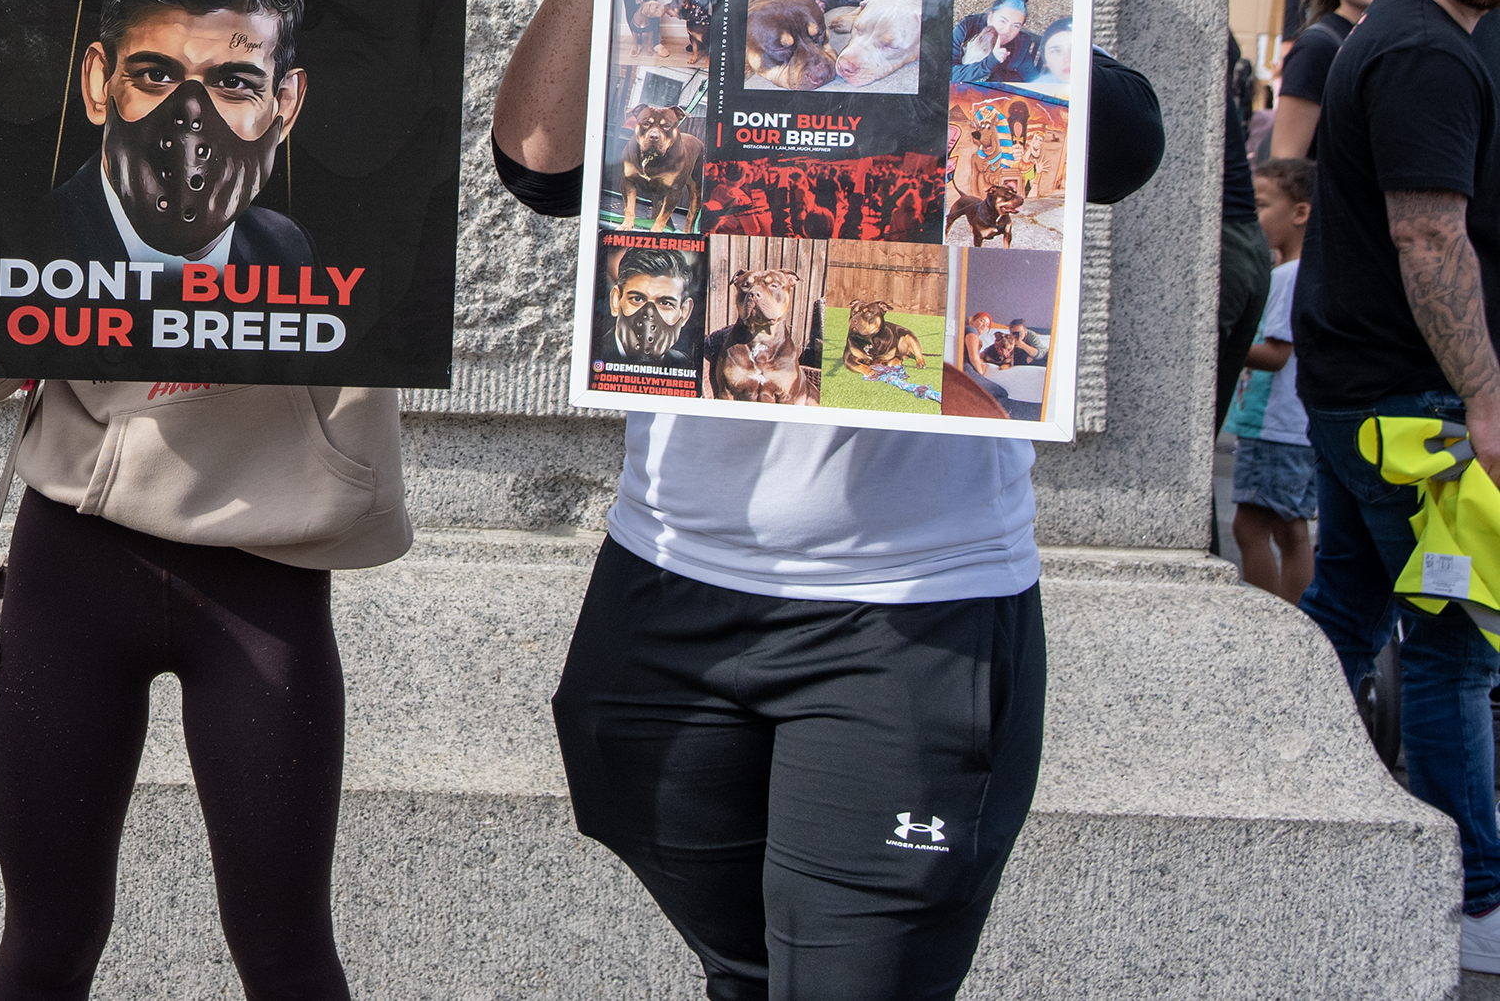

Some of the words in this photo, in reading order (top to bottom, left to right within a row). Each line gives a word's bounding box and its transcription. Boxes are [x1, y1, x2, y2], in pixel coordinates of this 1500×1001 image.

[721, 39, 727, 48] TO
[733, 111, 792, 128] DONT
[797, 114, 862, 131] BULLY
[736, 128, 780, 144] OUR
[785, 130, 855, 147] BREED
[603, 234, 705, 252] #MUZZLERISHI
[181, 263, 366, 306] BULLY
[7, 305, 133, 348] OUR
[151, 309, 346, 353] BREED
[605, 362, 697, 378] @DEMONBULLIESUK
[594, 373, 696, 389] #DONTBULLYMYBREED
[591, 382, 697, 398] #DONTBULLYOURBREED
[886, 839, 914, 849] UNDER
[914, 844, 950, 853] ARMOUR
